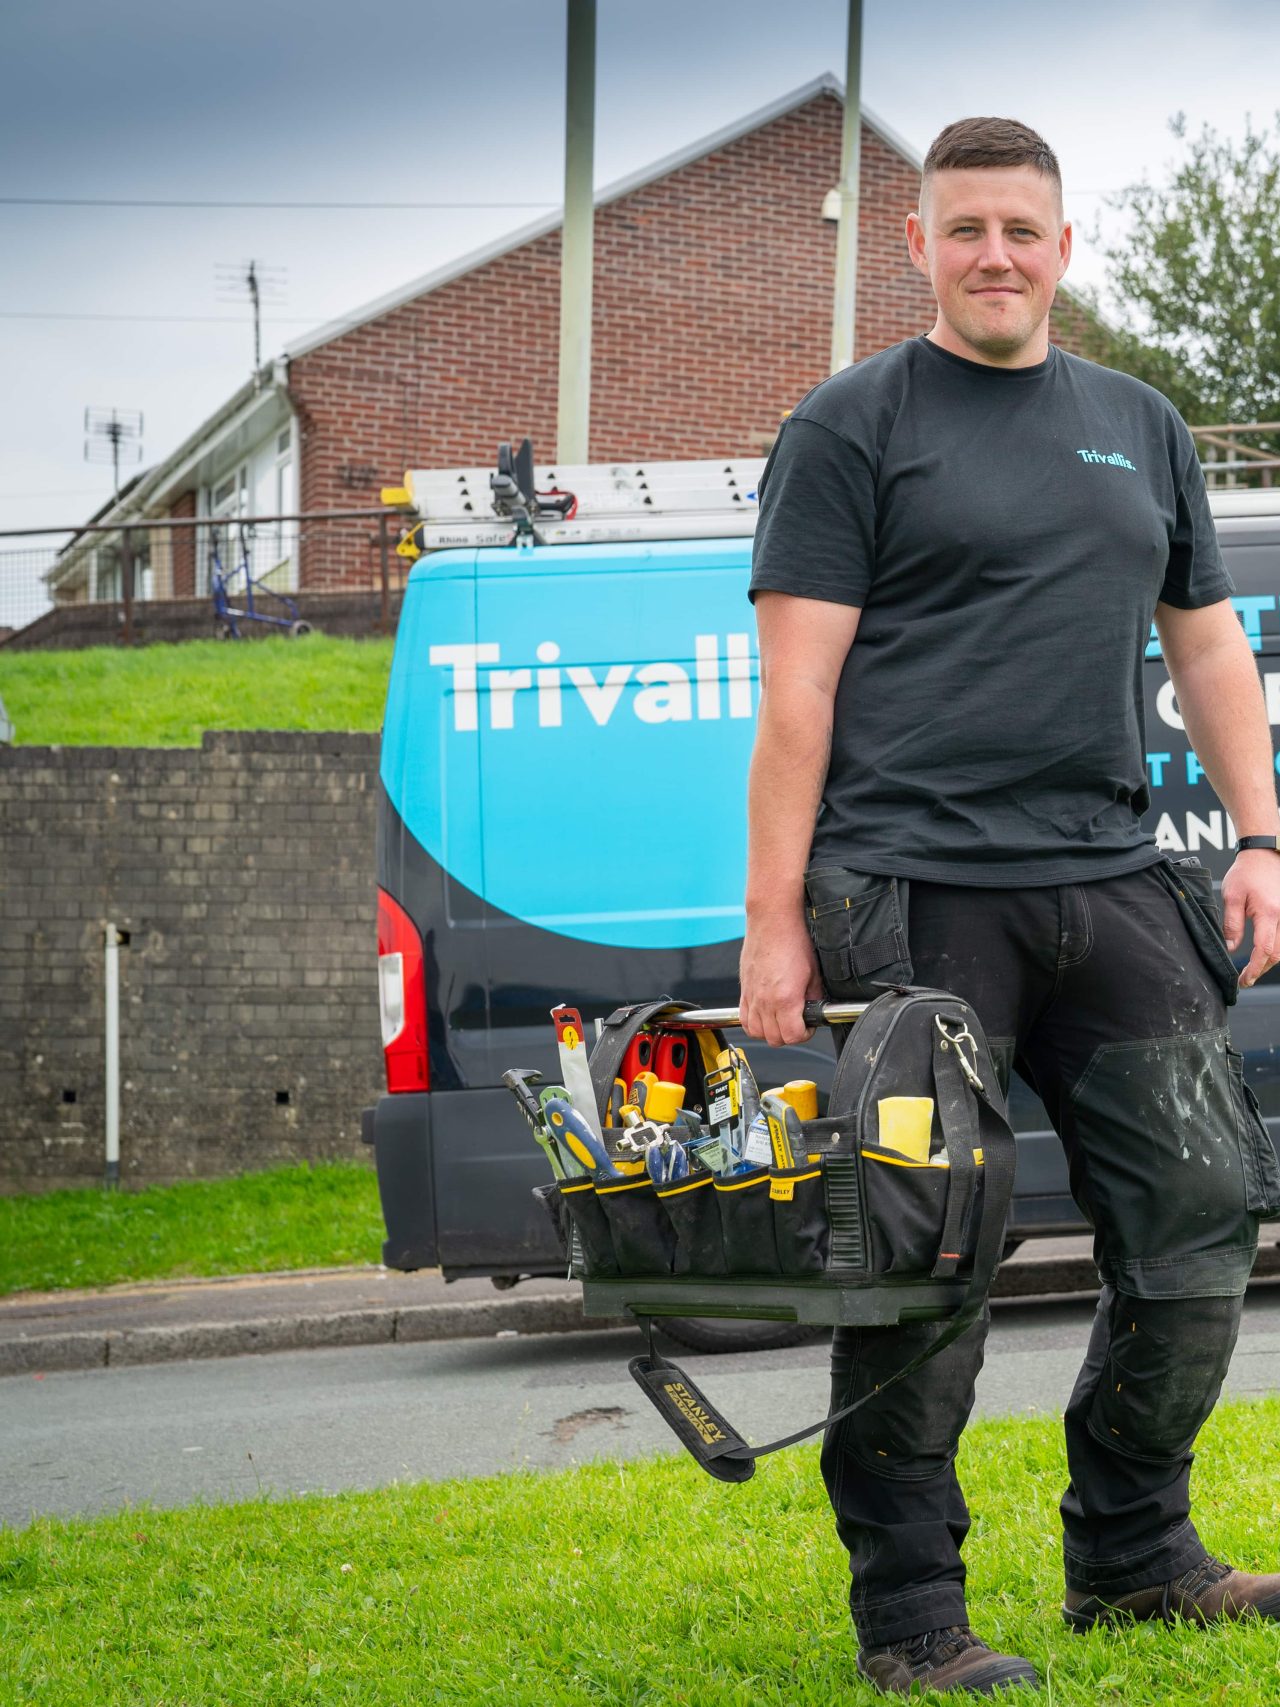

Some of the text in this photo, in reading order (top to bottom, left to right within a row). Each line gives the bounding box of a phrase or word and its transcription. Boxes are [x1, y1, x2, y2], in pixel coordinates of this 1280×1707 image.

[1077, 449, 1137, 472] Trivallis.
[429, 633, 763, 732] Trivall
[666, 1387, 712, 1440] FATMAX
[672, 1382, 726, 1441] STANLEY
